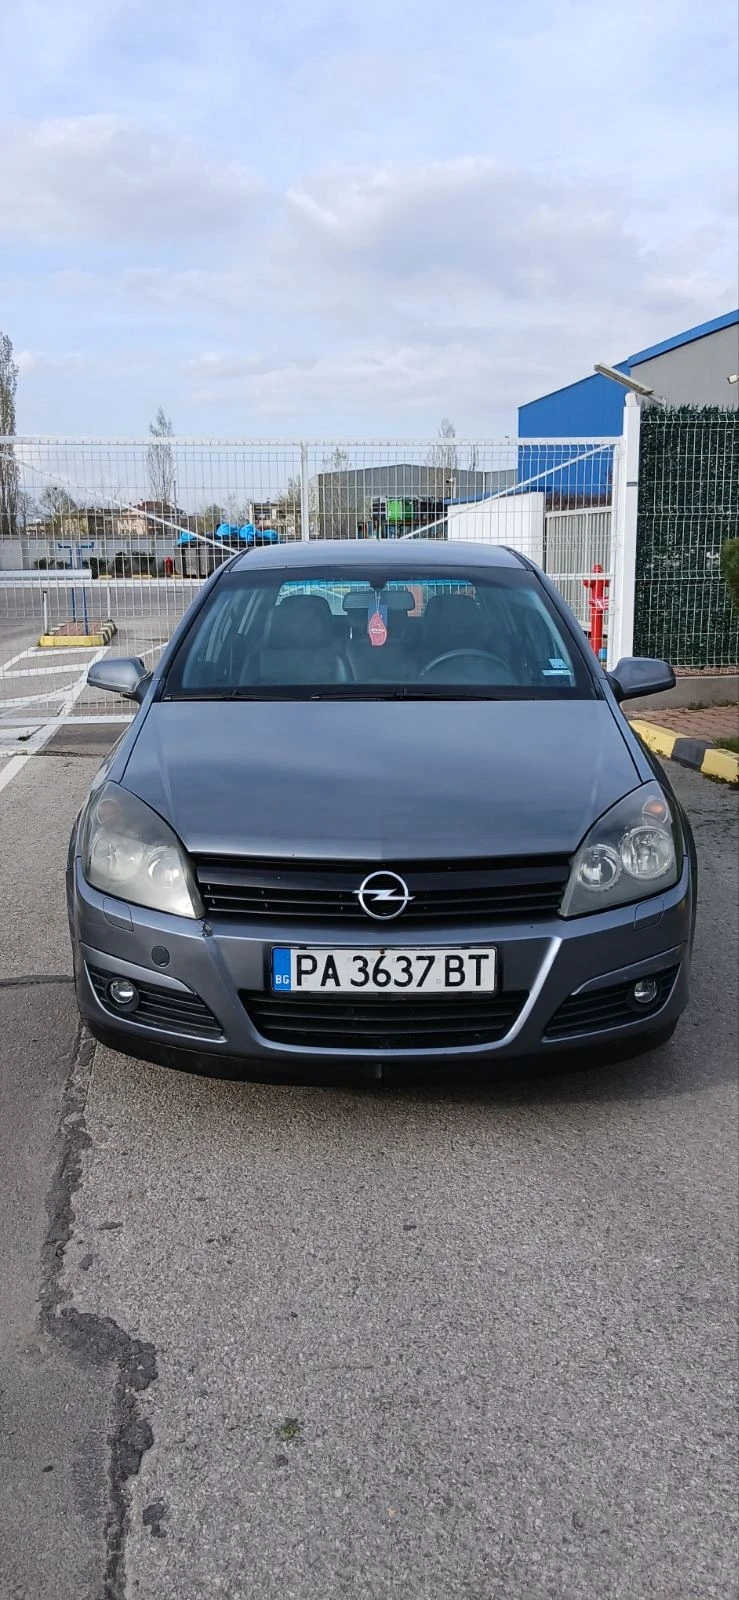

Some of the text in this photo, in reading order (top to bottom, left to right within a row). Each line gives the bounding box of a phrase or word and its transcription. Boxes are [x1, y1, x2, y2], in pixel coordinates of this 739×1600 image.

[275, 974, 290, 985] BG
[296, 954, 489, 987] PA 3637 BT
